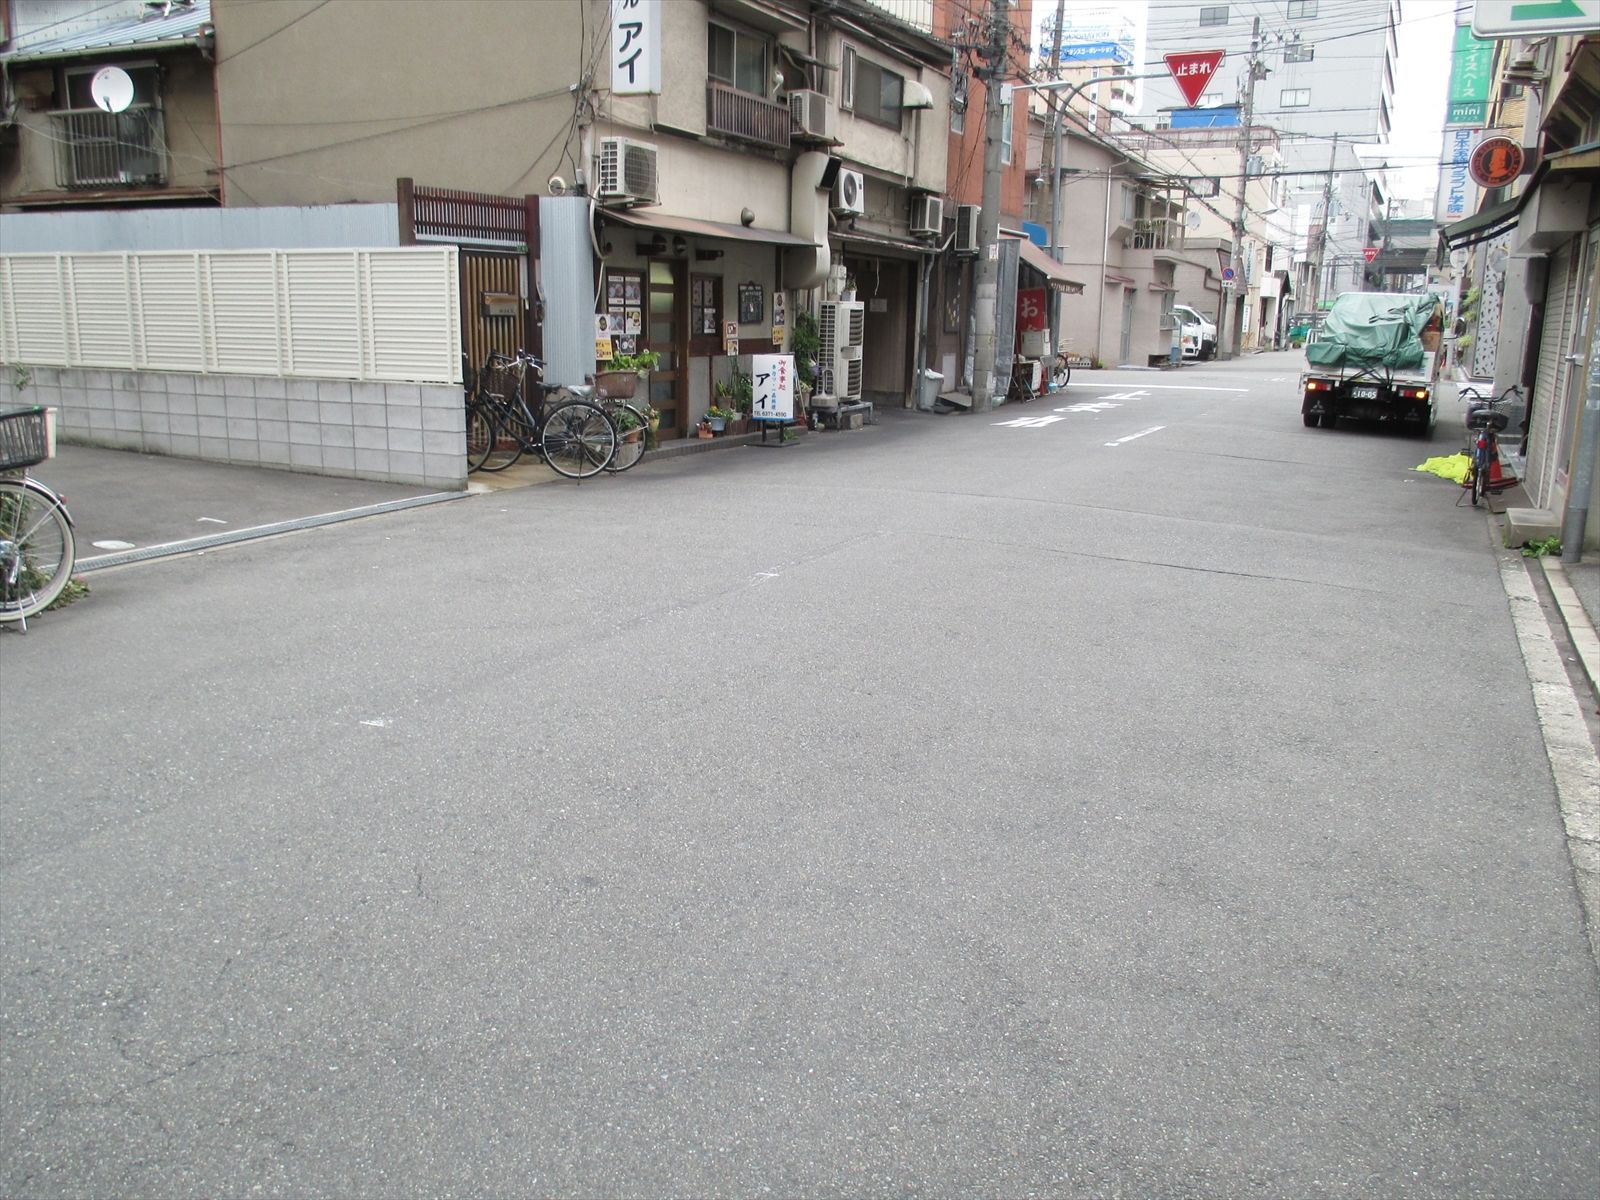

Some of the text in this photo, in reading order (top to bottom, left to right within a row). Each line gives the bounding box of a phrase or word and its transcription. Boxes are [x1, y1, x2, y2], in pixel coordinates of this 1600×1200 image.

[1176, 61, 1211, 76] 止まれ
[1452, 106, 1480, 115] mini
[755, 373, 770, 409] アイ
